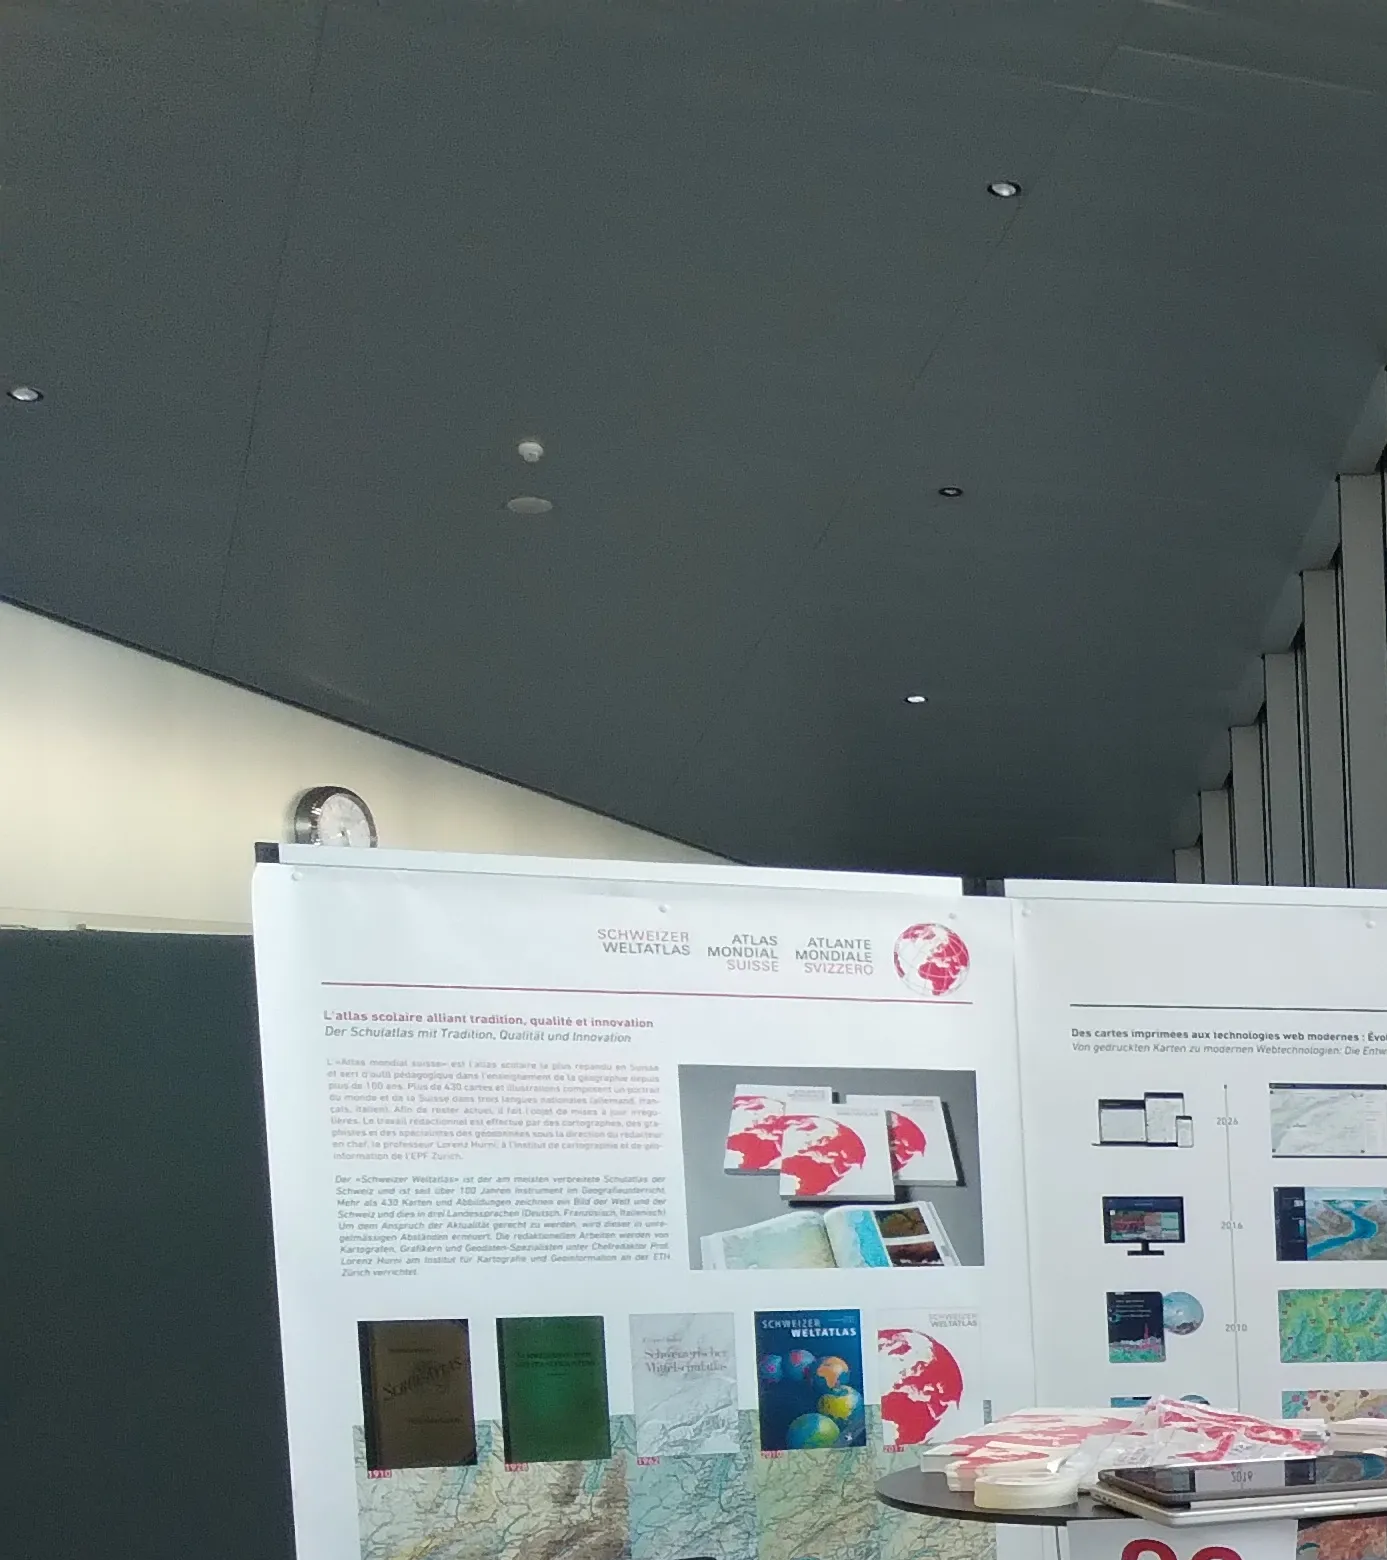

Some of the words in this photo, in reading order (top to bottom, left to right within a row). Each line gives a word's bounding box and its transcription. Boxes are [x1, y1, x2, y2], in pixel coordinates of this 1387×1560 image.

[597, 928, 690, 942] SCHWEIZER
[731, 934, 778, 946] ATLAS
[603, 941, 691, 956] WELTATLAS
[807, 937, 872, 950] ATLANTE
[707, 945, 779, 959] MONDIAL
[795, 949, 873, 963] MONDIALE
[726, 959, 780, 973] SUISSE
[804, 962, 874, 976] SVIZZERO
[323, 1009, 369, 1021] L'atlas
[368, 1011, 424, 1022] scolaire
[424, 1012, 467, 1023] alliant
[468, 1013, 527, 1026] tradition,
[528, 1015, 573, 1028] qualité
[575, 1017, 588, 1026] et
[590, 1016, 654, 1028] innovation
[323, 1025, 349, 1037] Der
[414, 1028, 438, 1038] mit
[438, 1027, 498, 1040] Tradition,
[497, 1029, 546, 1041] Qualität
[546, 1031, 571, 1042] und
[570, 1031, 632, 1043] Innovation
[1070, 1028, 1092, 1037] Des
[1093, 1029, 1129, 1038] cartes
[1190, 1031, 1211, 1039] aux
[1212, 1031, 1280, 1042] technologies
[1282, 1031, 1305, 1040] web
[1306, 1032, 1360, 1041] modernes
[1071, 1041, 1092, 1051] Von
[1091, 1042, 1151, 1054] gedruckten
[1151, 1043, 1188, 1053] Karten
[1202, 1045, 1255, 1054] modernen
[1254, 1044, 1343, 1057] Webtechnologien:
[1342, 1045, 1362, 1055] Die
[1216, 1117, 1239, 1125] 2026
[1220, 1222, 1243, 1230] 2016
[761, 1318, 821, 1329] SCHWEIZER
[1225, 1324, 1248, 1332] 2010
[791, 1327, 857, 1338] WELTATLAS
[368, 1469, 391, 1479] 1910
